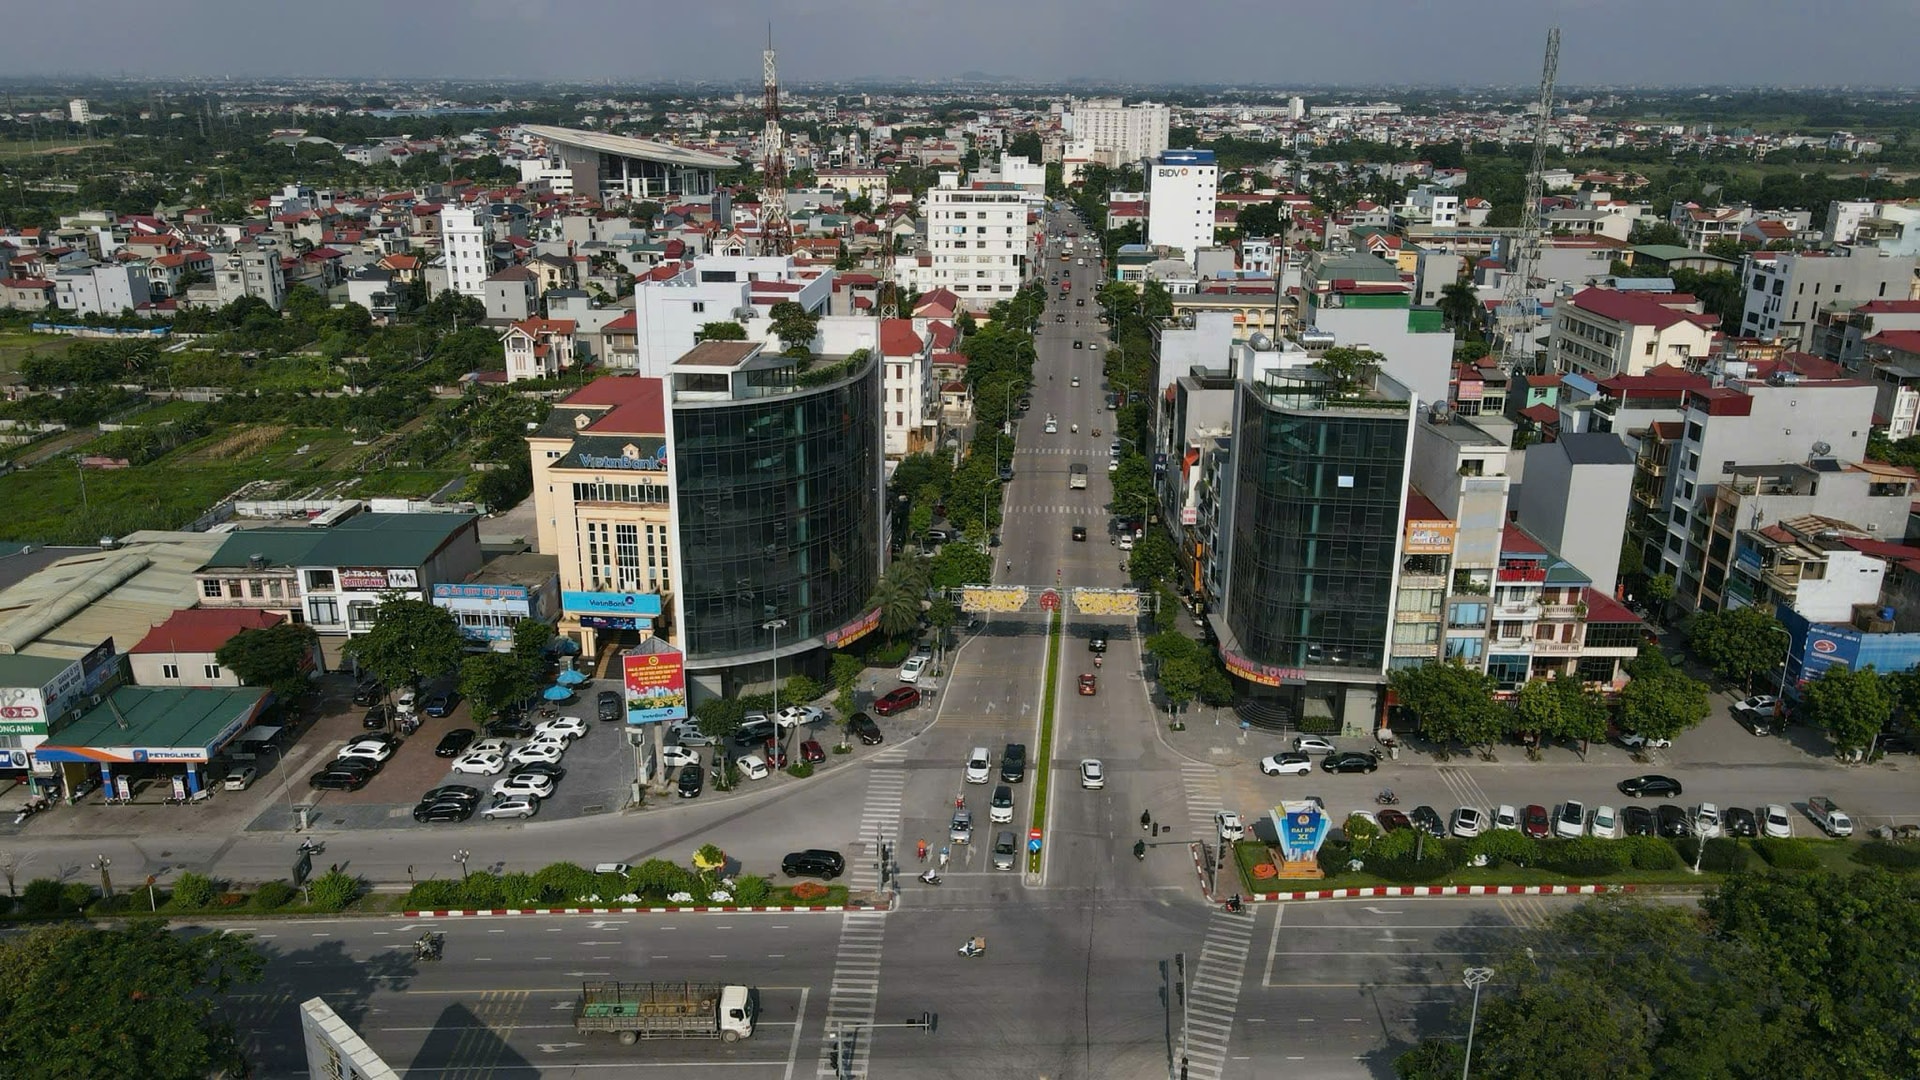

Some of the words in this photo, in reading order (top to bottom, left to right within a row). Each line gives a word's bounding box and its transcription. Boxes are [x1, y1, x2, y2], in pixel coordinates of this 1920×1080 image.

[1159, 168, 1180, 177] BIDV
[1261, 665, 1306, 680] TOWER
[17, 725, 34, 733] ANH
